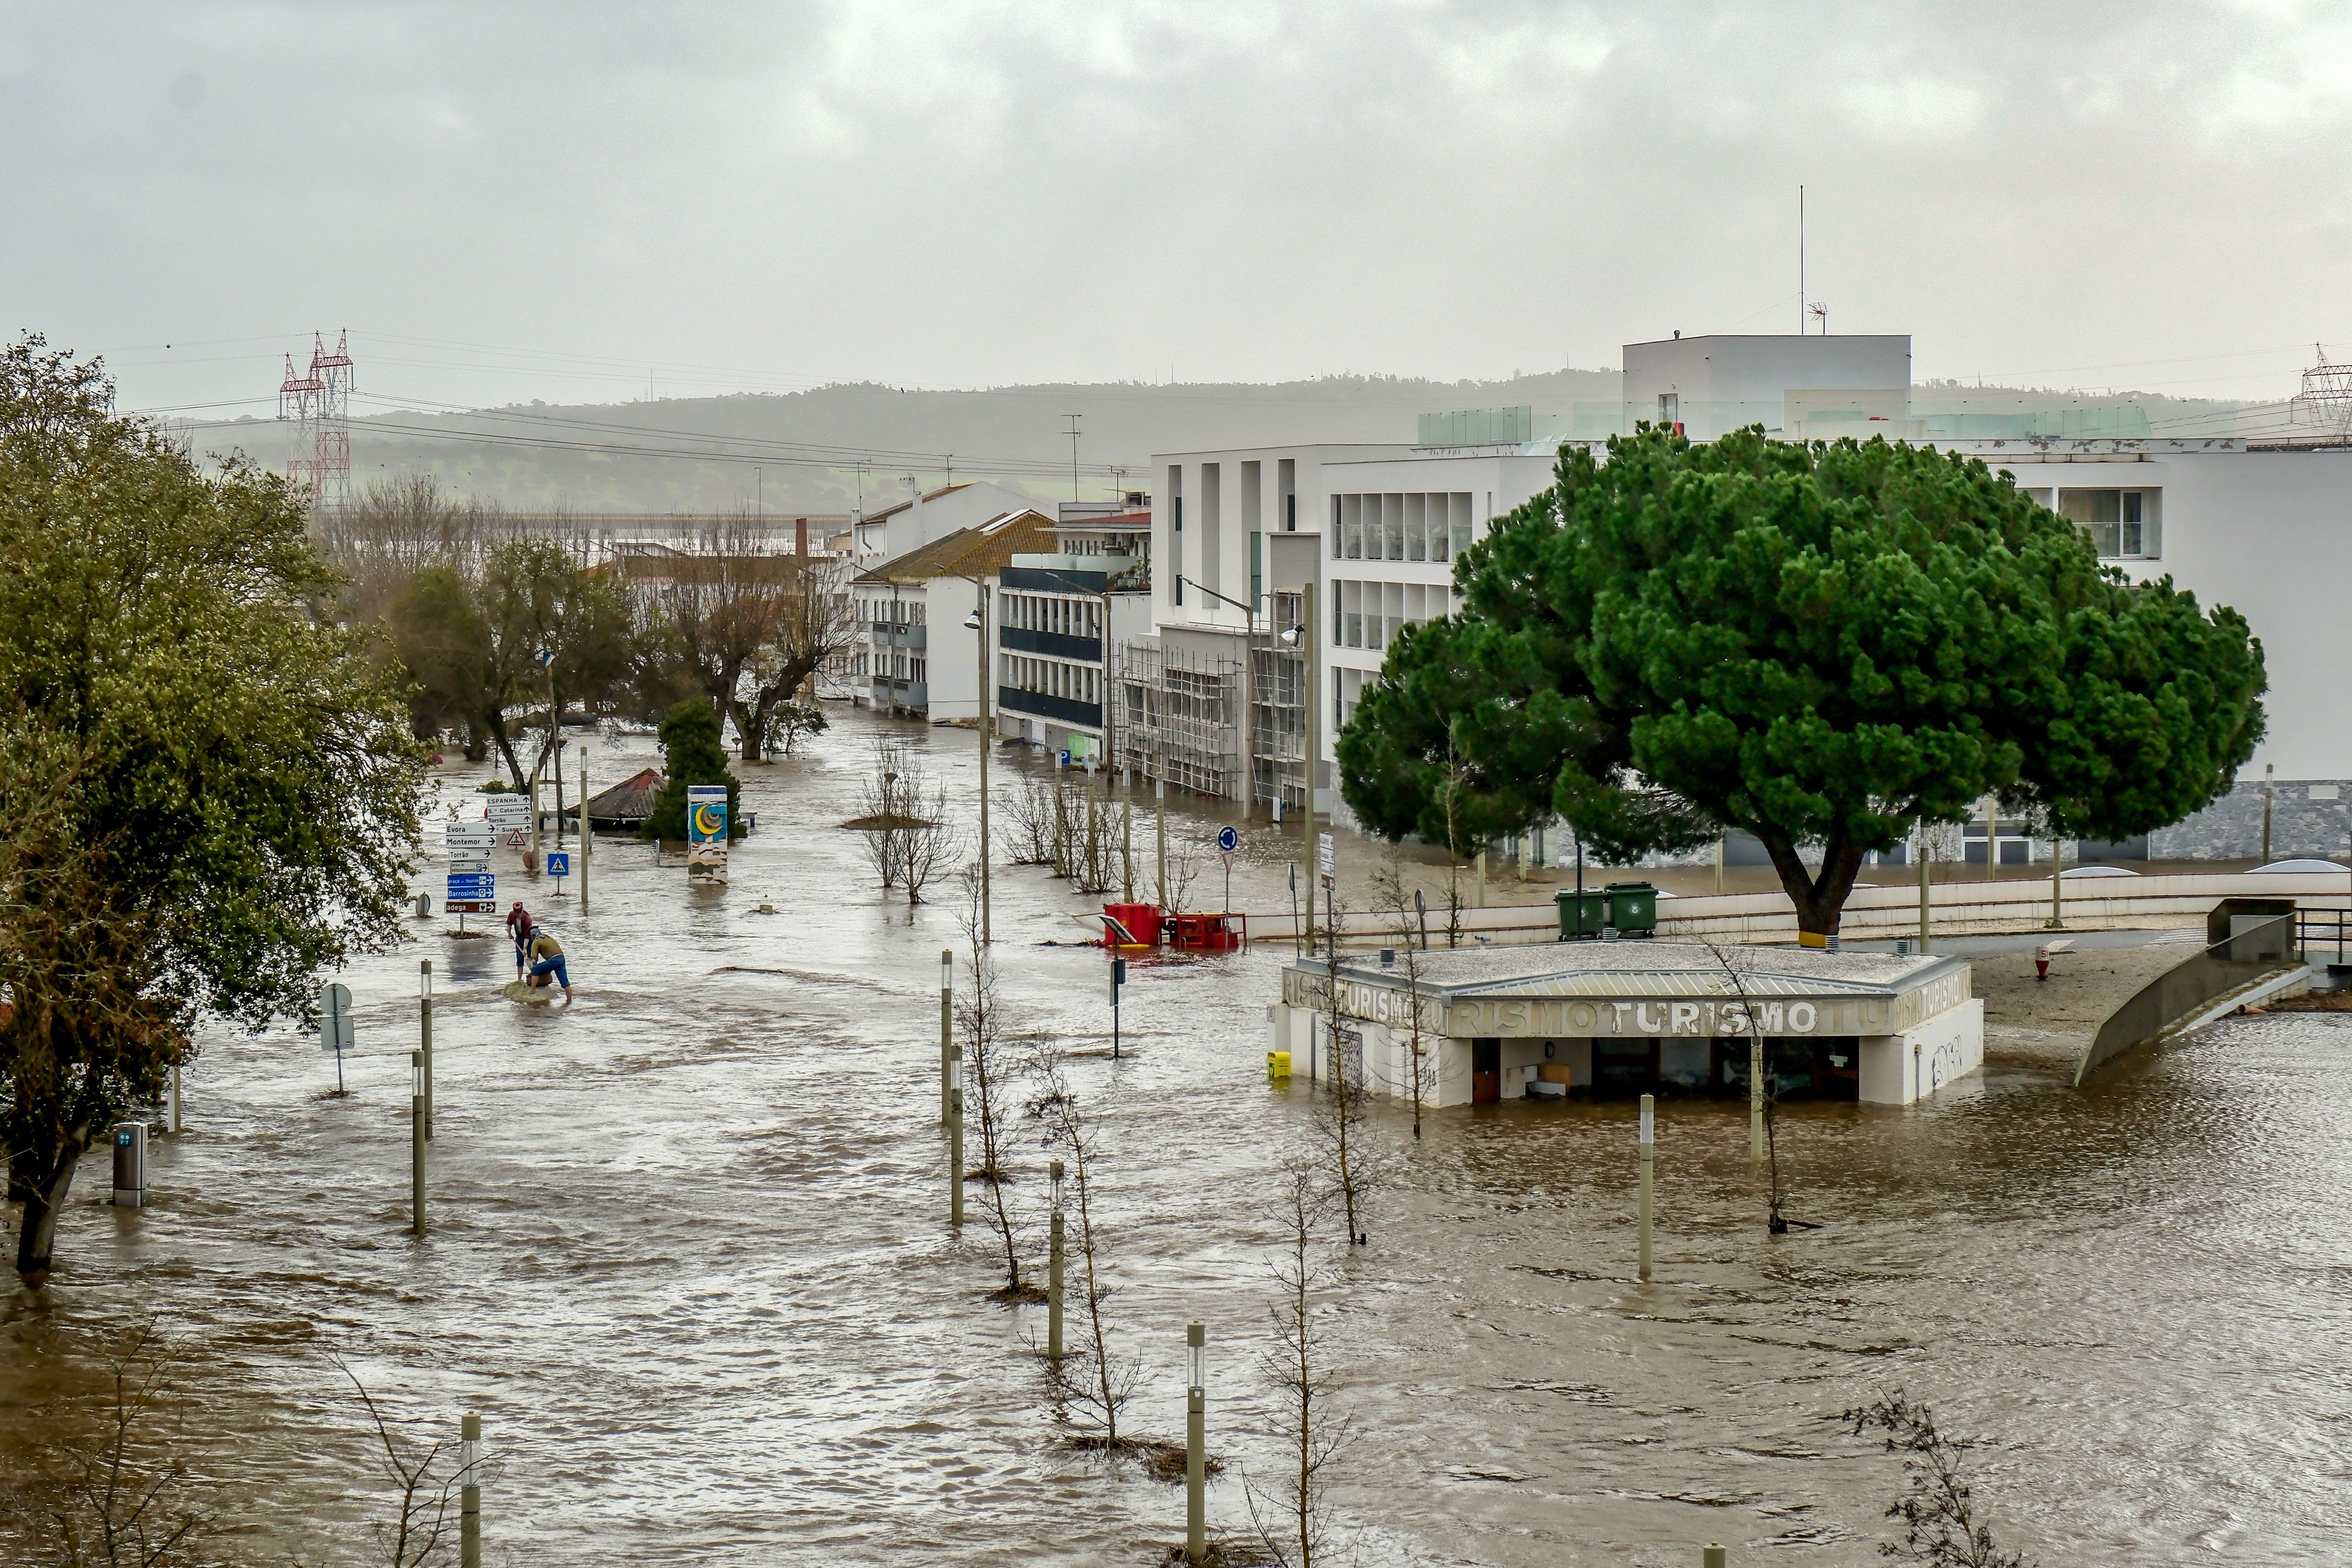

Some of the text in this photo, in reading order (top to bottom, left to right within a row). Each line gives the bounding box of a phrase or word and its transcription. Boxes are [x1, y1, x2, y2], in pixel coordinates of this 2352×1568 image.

[1336, 982, 1415, 1026] TURISMO
[1923, 973, 1959, 1017] TURISMO
[1450, 1001, 1889, 1034] RISMO TURISMO TU
